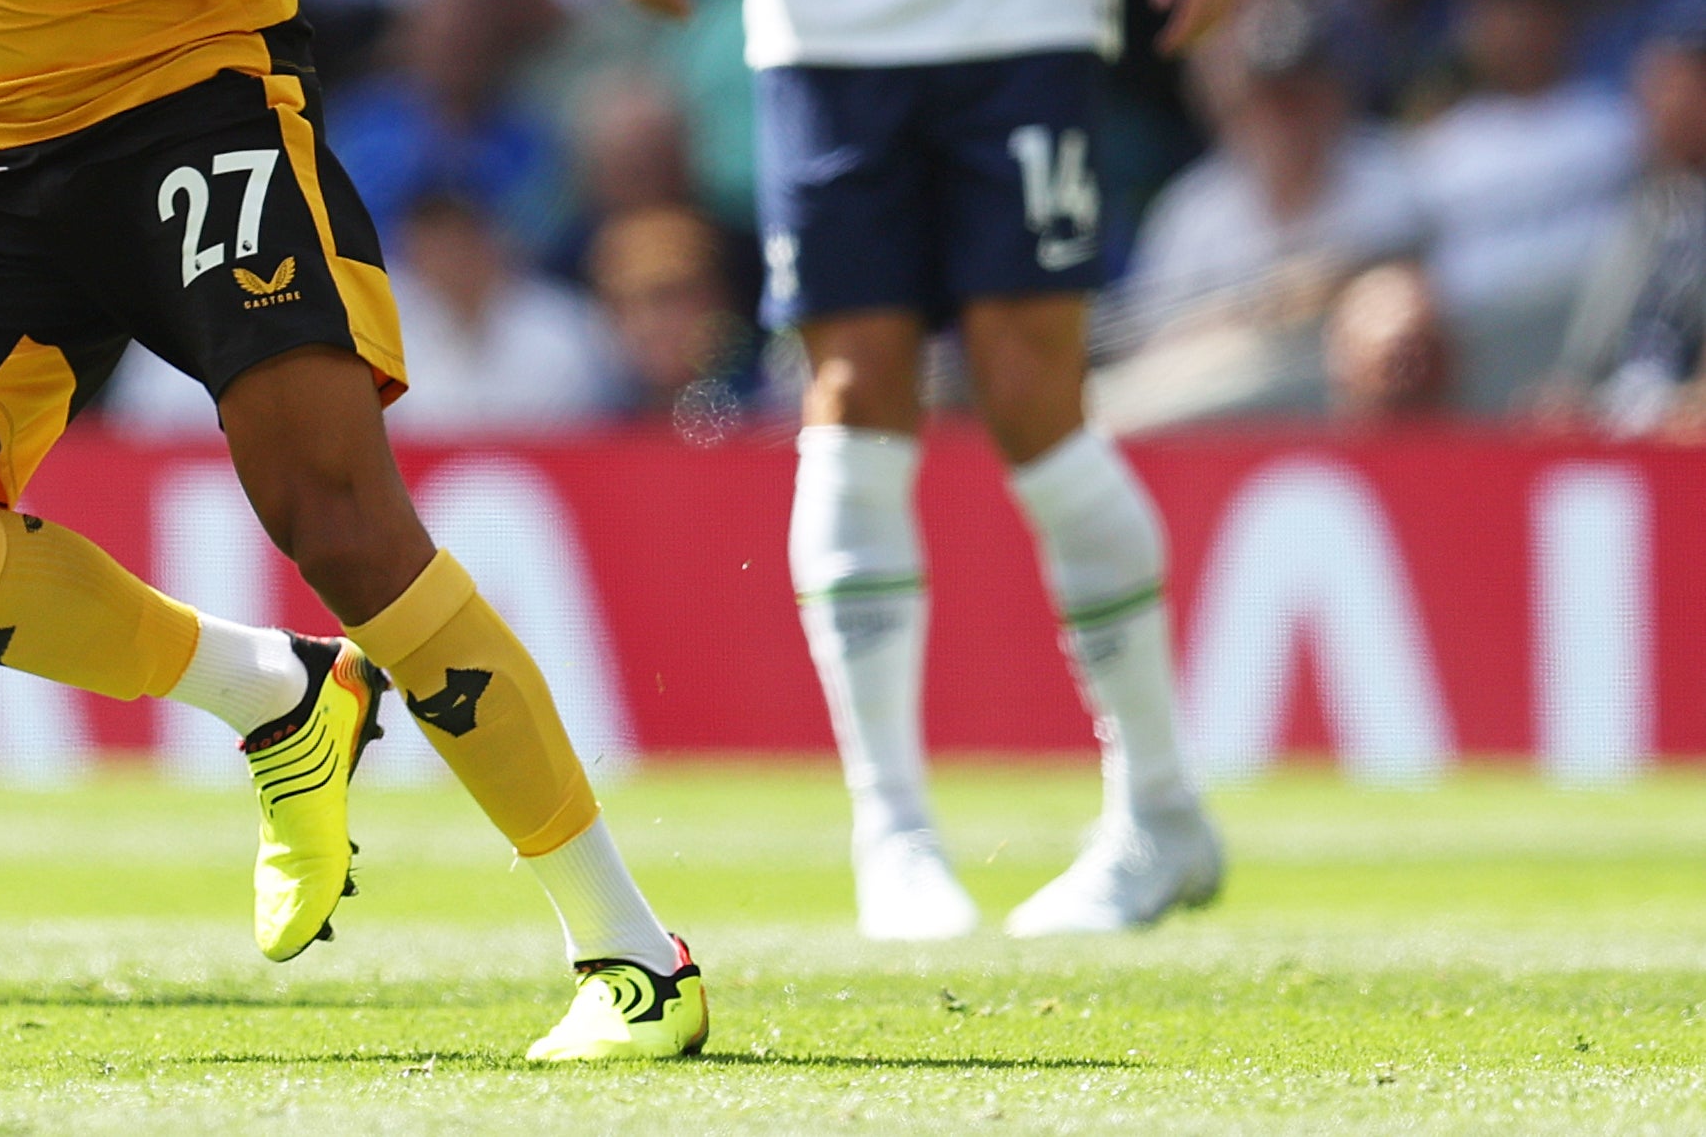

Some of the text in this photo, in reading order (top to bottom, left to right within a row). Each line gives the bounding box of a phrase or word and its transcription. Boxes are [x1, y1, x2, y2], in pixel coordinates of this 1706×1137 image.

[157, 148, 280, 289] 27
[1006, 123, 1102, 234] 14
[243, 290, 302, 311] CASTORE
